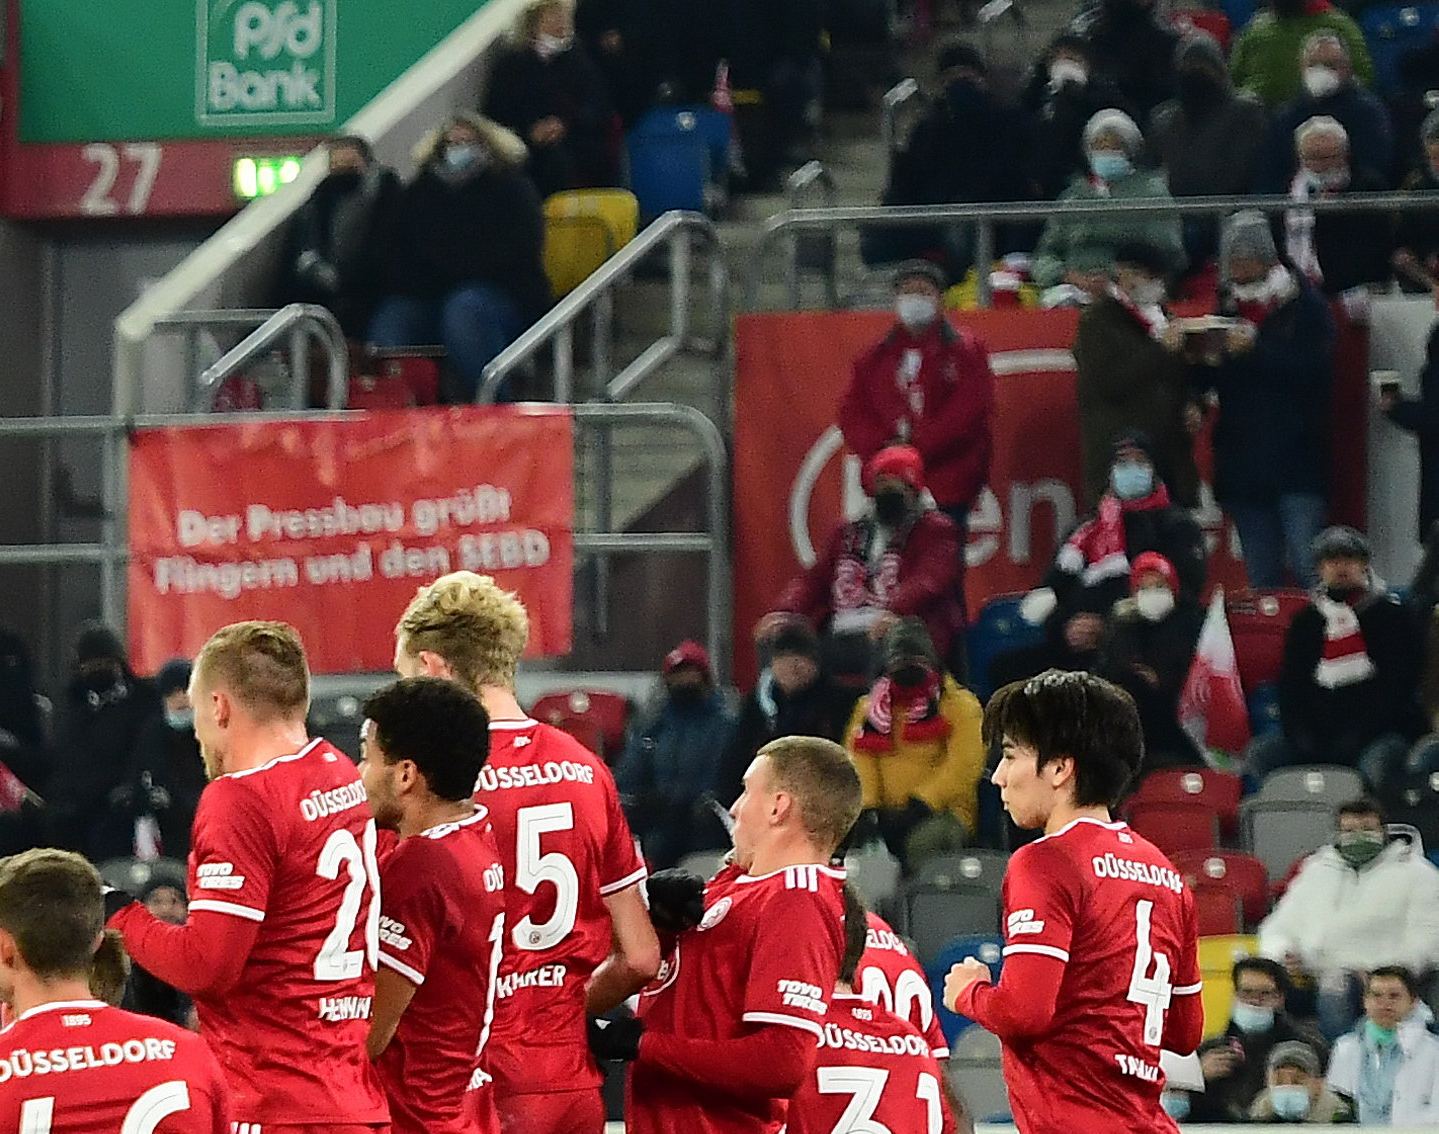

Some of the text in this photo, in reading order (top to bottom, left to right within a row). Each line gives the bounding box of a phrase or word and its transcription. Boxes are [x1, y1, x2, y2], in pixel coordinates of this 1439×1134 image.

[209, 58, 322, 110] Bank
[80, 142, 163, 216] 27
[178, 509, 243, 548] Der
[305, 541, 374, 584] und
[379, 539, 451, 580] den
[512, 802, 579, 951] 5
[777, 979, 823, 1000] TOYO
[1126, 899, 1172, 1046] 4
